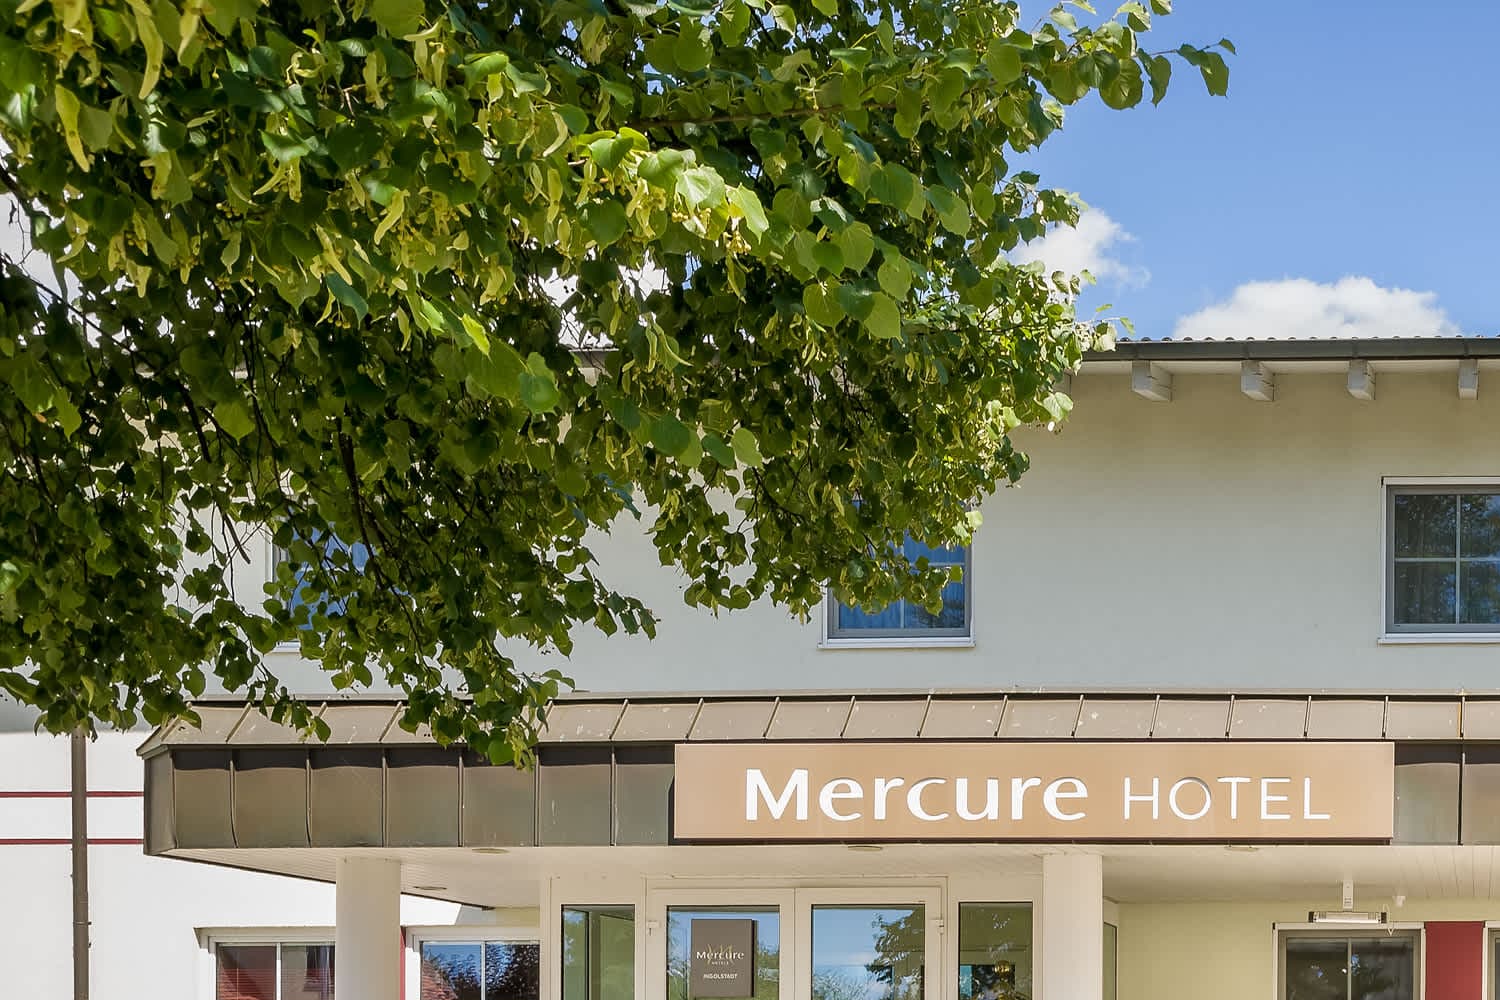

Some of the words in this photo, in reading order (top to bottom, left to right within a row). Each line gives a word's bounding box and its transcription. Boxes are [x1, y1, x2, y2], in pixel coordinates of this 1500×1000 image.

[745, 768, 1088, 821] Mercure
[1124, 777, 1331, 820] HOTEL
[696, 951, 745, 960] Mercure
